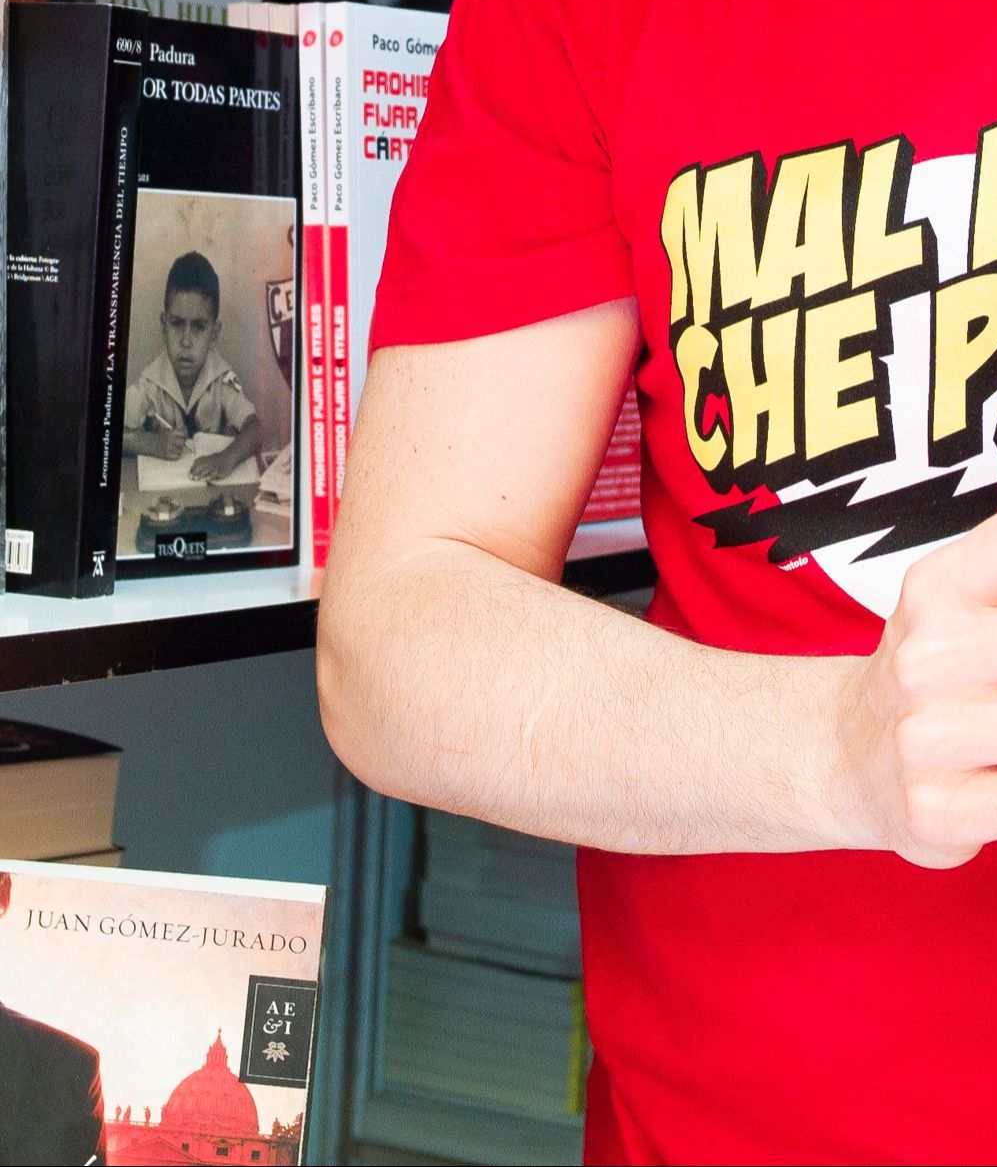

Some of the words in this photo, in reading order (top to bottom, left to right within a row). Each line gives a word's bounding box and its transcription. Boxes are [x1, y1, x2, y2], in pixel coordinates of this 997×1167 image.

[116, 37, 143, 55] 690/8
[150, 42, 196, 67] Padura
[372, 34, 400, 52] Paco
[142, 77, 168, 100] OR
[171, 80, 226, 106] TODAS
[228, 86, 281, 112] PARTES
[308, 76, 317, 135] Escribano
[333, 76, 342, 135] Escribano
[363, 102, 419, 131] FIJAR
[117, 127, 129, 186] TIEMPO
[308, 138, 318, 179] Gómez
[334, 138, 343, 180] Gómez
[116, 189, 125, 219] DEL
[310, 182, 319, 212] Paco
[335, 182, 343, 212] Paco
[661, 135, 935, 331] MAL
[108, 223, 123, 348] TRANSPARENCIA
[106, 353, 115, 372] LA
[103, 384, 114, 426] Padura
[312, 377, 325, 419] FIJAR
[334, 380, 347, 421] FIJAR
[675, 290, 885, 479] CHE
[100, 430, 112, 487] Leonardo
[313, 421, 327, 498] PROHIBIDO
[24, 908, 92, 933] JUAN
[99, 913, 308, 955] GÓMEZ-JURADO
